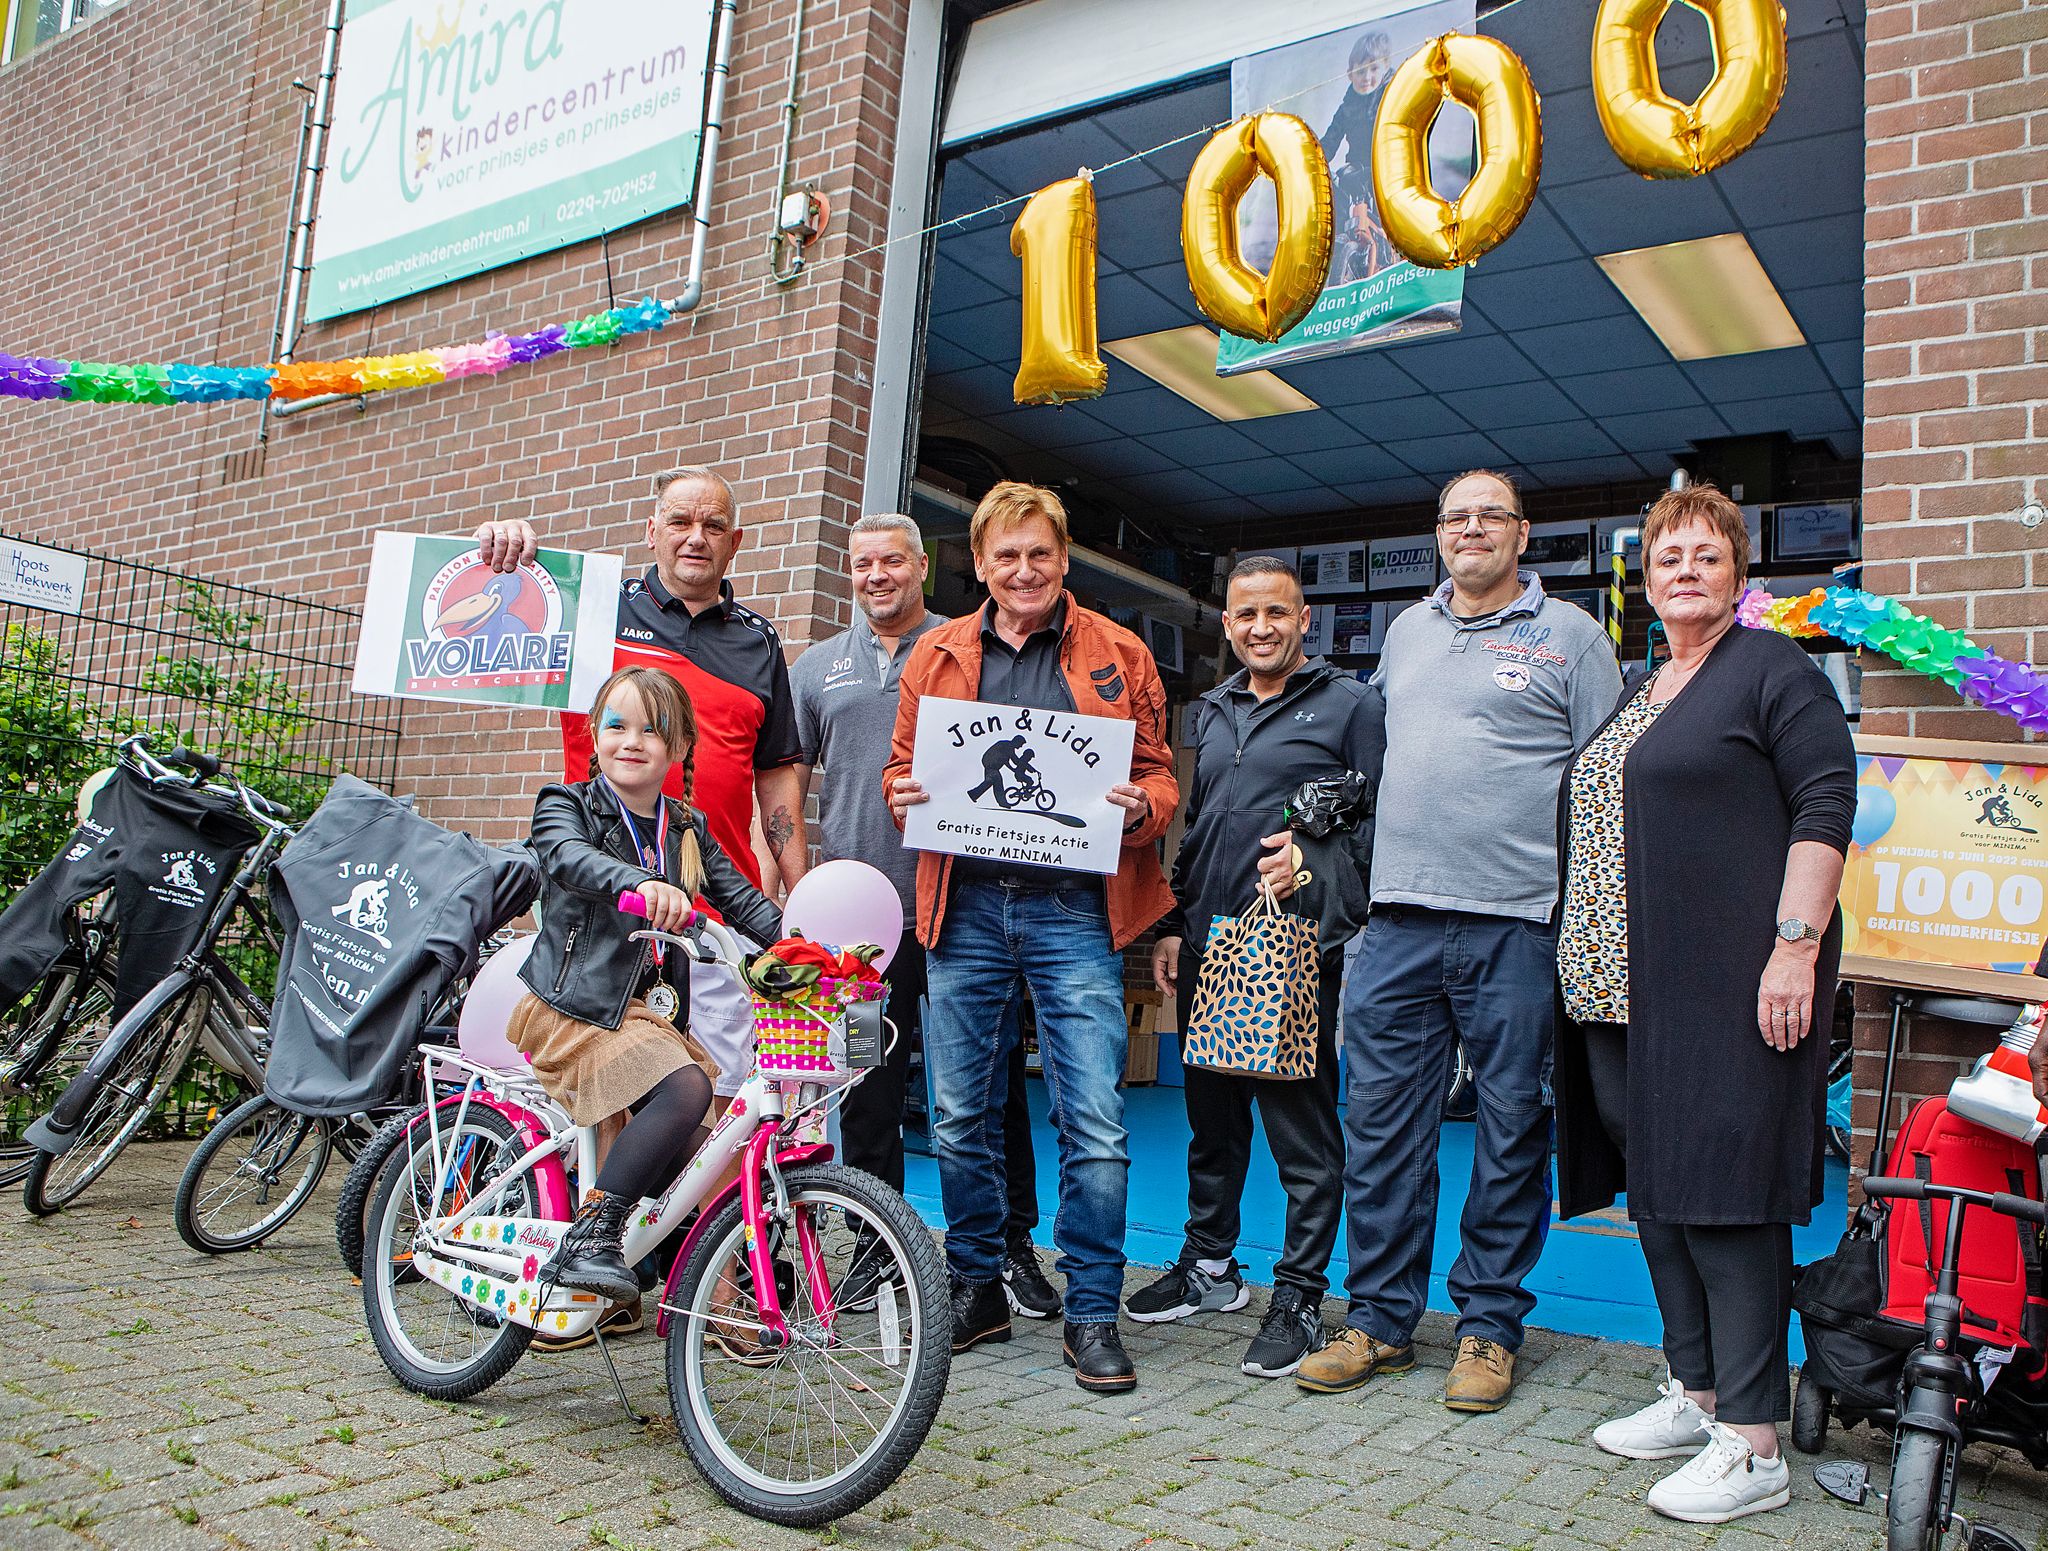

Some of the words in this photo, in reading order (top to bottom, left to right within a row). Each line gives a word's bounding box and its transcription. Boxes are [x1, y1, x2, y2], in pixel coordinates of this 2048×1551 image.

[340, 0, 564, 203] Amira
[440, 44, 687, 162] kindercentrum
[437, 163, 475, 191] voor
[479, 139, 549, 177] prinsjes
[556, 128, 576, 149] en
[582, 85, 682, 144] prinsesjes
[338, 215, 530, 293] www.amirakindercentrum.nl
[556, 170, 657, 222] 0229-702452
[1318, 295, 1346, 313] dan
[1386, 267, 1436, 293] fietsen
[1303, 296, 1394, 337] weggegeven!
[12, 549, 50, 573] Hoots
[1371, 565, 1434, 577] TEAMSPORT
[1389, 549, 1433, 566] DUIJN
[15, 567, 72, 594] Hekwerk
[428, 556, 471, 601] PASSION
[528, 563, 557, 596] ALITY
[621, 627, 654, 641] JAKO
[406, 632, 573, 679] VOLARE
[831, 657, 852, 673] SvD
[1496, 651, 1520, 660] ECOLE
[1532, 657, 1544, 665] SKI
[410, 673, 561, 690] BICYCLES
[947, 715, 1003, 748] Jan
[1015, 708, 1033, 731] &
[1044, 714, 1101, 769] Lida
[1964, 784, 1992, 802] Jan
[1997, 783, 2008, 794] &
[2013, 785, 2044, 809] Lida
[937, 819, 982, 836] Gratis
[986, 825, 1046, 847] Fietsjes
[1051, 832, 1090, 850] Actie
[1960, 831, 1984, 839] Gratis
[1985, 833, 2017, 842] Fietsjes
[1993, 843, 2027, 851] MINIMA
[161, 852, 184, 864] Jan
[187, 850, 196, 860] &
[197, 854, 217, 875] Lida
[964, 843, 995, 857] voor
[999, 847, 1063, 865] MINIMA
[1876, 846, 1888, 855] OP
[1891, 845, 1939, 859] VRIJDAG
[1942, 849, 1955, 861] 10
[1958, 851, 1985, 863] JUNI
[1987, 854, 2018, 867] 2022
[148, 885, 168, 894] Gratis
[168, 890, 191, 900] Fietsjes
[157, 895, 171, 903] voor
[338, 861, 378, 879] Jan
[384, 863, 399, 879] &
[399, 869, 419, 909] Lida
[1873, 861, 2044, 926] 1000
[301, 920, 332, 940] Gratis
[331, 933, 372, 957] Fietsjes
[372, 950, 387, 964] Actie
[1867, 916, 1920, 934] GRATIS
[1923, 921, 2040, 946] KINDERFIETSJE
[312, 941, 333, 955] voor
[334, 948, 375, 974] MINIMA
[517, 1225, 557, 1257] Ashley
